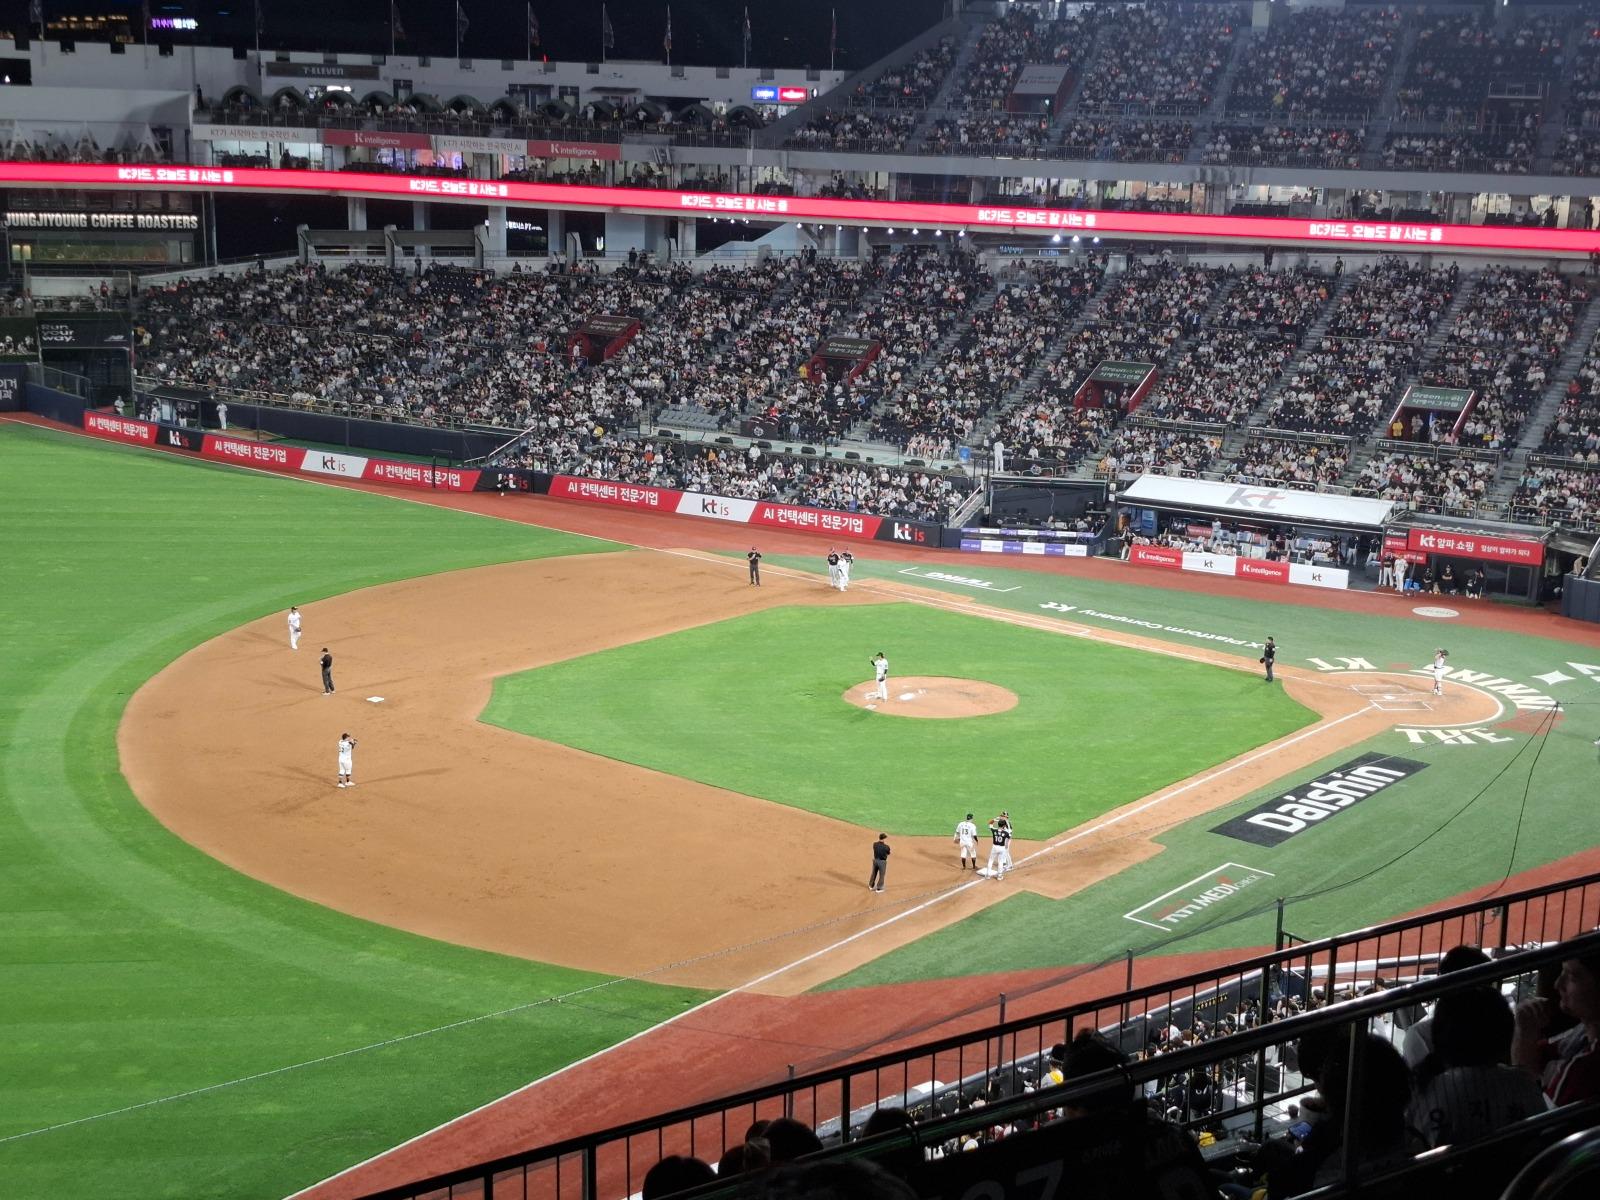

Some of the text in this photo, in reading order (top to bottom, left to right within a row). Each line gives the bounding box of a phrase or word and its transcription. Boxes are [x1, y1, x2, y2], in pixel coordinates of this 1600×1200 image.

[560, 147, 597, 157] intelligence
[4, 212, 199, 230] JUNGJIYOUNG COFFEE ROASTERS
[123, 422, 149, 439] 전문기업
[170, 430, 181, 446] kt
[214, 440, 287, 463] AI 컨택센터 전문기업
[322, 455, 346, 472] kt is
[374, 464, 461, 487] AI 컨택센터 전문기업
[568, 482, 659, 506] AI 컨택센터 전문기업
[1225, 487, 1287, 510] kt
[702, 498, 729, 516] kt is
[763, 508, 863, 533] AI 컨택센터 전문기업
[893, 522, 925, 542] kt is
[1420, 534, 1436, 548] kt
[1146, 554, 1176, 563] intelligence
[1204, 559, 1213, 569] kt
[1242, 564, 1282, 576] K intelligence
[1311, 572, 1323, 582] kt
[1039, 601, 1078, 613] kt
[1078, 609, 1163, 629] Company
[1164, 626, 1247, 645] Platform
[1306, 657, 1377, 670] KT
[1394, 727, 1514, 744] THE
[1245, 765, 1407, 834] Daishin
[994, 835, 1003, 843] 10
